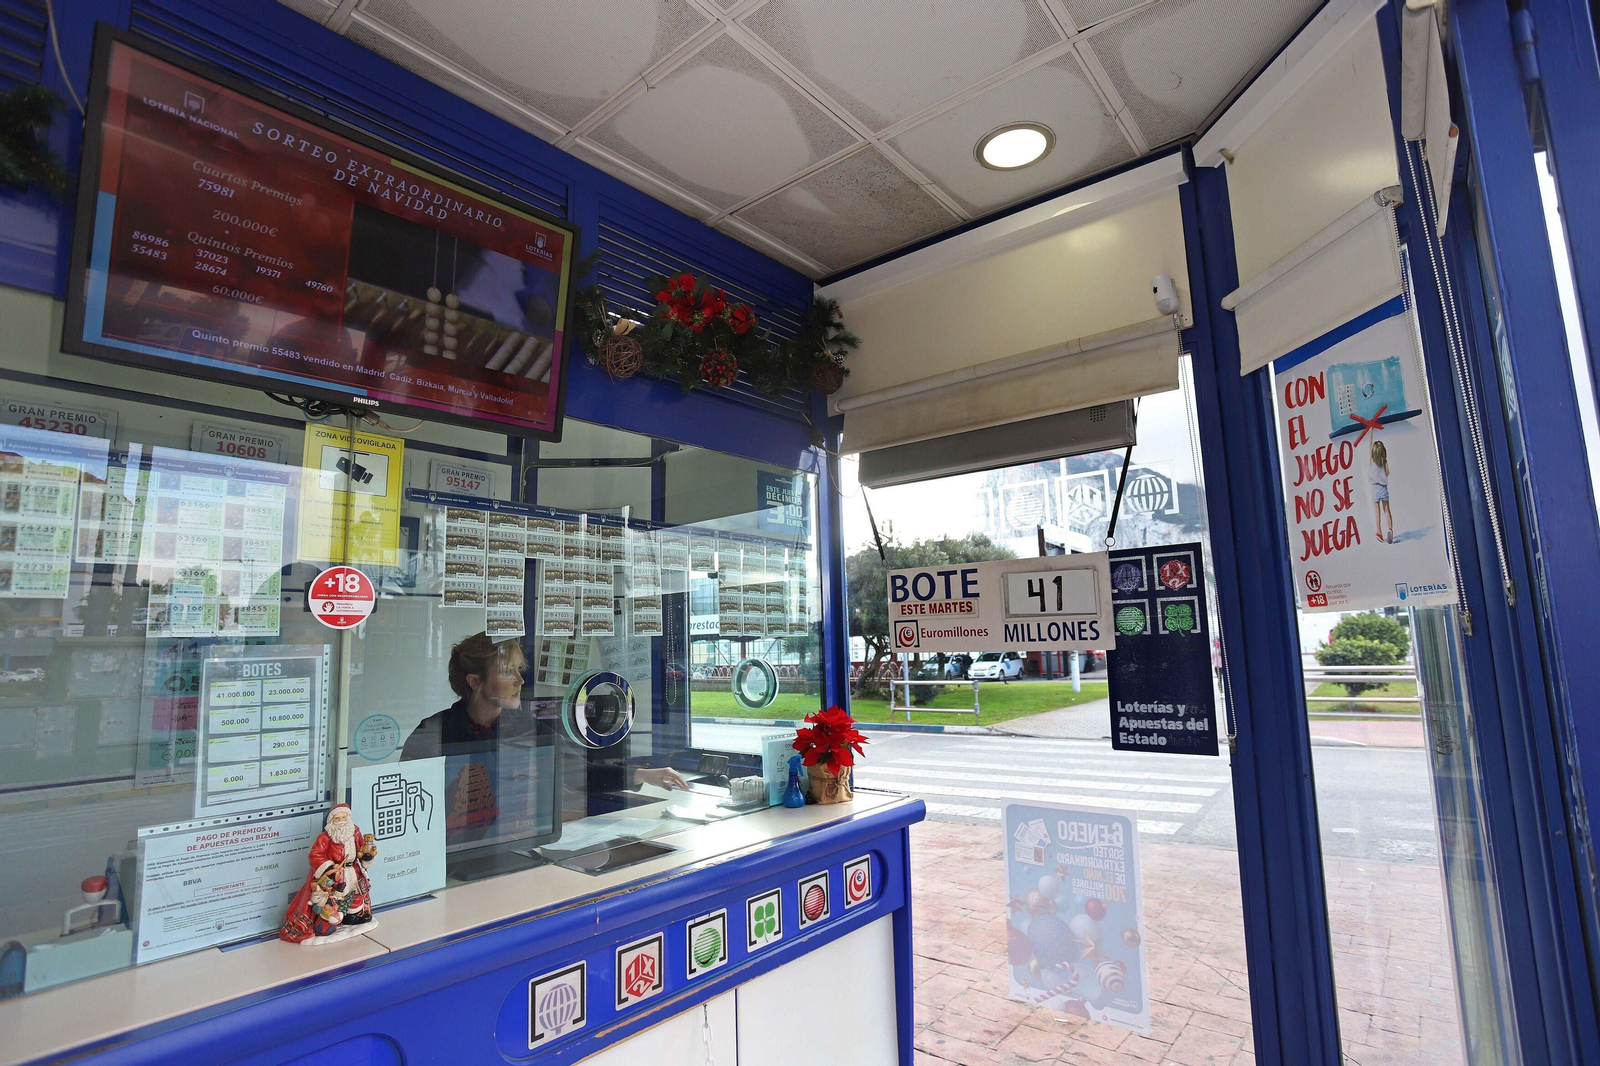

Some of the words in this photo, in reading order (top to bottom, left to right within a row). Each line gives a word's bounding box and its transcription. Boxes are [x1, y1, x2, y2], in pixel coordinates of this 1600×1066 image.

[142, 96, 186, 118] LOTERÍA
[189, 114, 239, 139] NACIONAL
[193, 160, 248, 187] Cuartos
[251, 181, 303, 206] Premios
[252, 121, 337, 163] SORTEO
[346, 159, 504, 229] EXTRAORDINARIO
[197, 178, 235, 199] 75981
[333, 168, 359, 188] DE
[366, 181, 448, 221] NAVIDAD
[212, 209, 279, 237] 200.000€
[131, 230, 169, 248] 86986
[131, 244, 167, 260] 55483
[187, 231, 241, 254] Quintos
[244, 247, 294, 270] Premios
[195, 248, 229, 264] 37023
[525, 244, 553, 259] LOTERÍAS
[194, 261, 228, 276] 28674
[256, 265, 281, 279] 19371
[211, 284, 264, 304] 60.000€
[304, 280, 334, 293] 49760
[192, 329, 230, 345] Quinto
[232, 339, 269, 355] premio
[272, 347, 301, 361] 55483
[303, 354, 340, 370] vendido
[342, 364, 354, 372] en
[447, 385, 472, 397] Murcia
[473, 391, 479, 400] y
[480, 391, 514, 406] Valladolid
[1284, 371, 1326, 410] CON
[353, 396, 380, 407] PHILIPS
[8, 404, 45, 416] GRAN
[50, 410, 97, 423] PREMIO
[18, 417, 87, 436] 45230
[1288, 415, 1310, 450] EL
[208, 430, 236, 441] GRAN
[239, 435, 274, 448] PREMIO
[315, 431, 337, 441] ZONA
[216, 441, 267, 459] 10608
[1293, 440, 1354, 487] JUEGO
[441, 467, 459, 477] GRAN
[462, 472, 486, 482] PREMIO
[446, 476, 481, 491] 95147
[766, 485, 780, 494] ESTE
[1295, 489, 1325, 524] NO
[1333, 476, 1355, 512] SE
[786, 518, 803, 527] EUROS
[1300, 515, 1361, 562] JUEGA
[323, 573, 360, 593] +18
[891, 568, 980, 602] BOTE
[1409, 583, 1448, 593] LOTERÍAS
[1027, 576, 1064, 613] 41
[1310, 594, 1325, 605] +18
[900, 602, 926, 616] ESTE
[928, 600, 973, 614] MARTES
[920, 626, 989, 639] Euromillones
[1004, 620, 1101, 643] MILLONES
[243, 662, 282, 677] BOTES
[216, 690, 256, 699] 41.000.000
[268, 687, 305, 696] 23.000.000
[1117, 700, 1174, 714] Loterías
[1176, 703, 1186, 717] y
[221, 717, 250, 726] 500.000
[268, 713, 304, 722] 10.800.000
[1118, 716, 1184, 735] Apuestas
[1186, 717, 1209, 732] del
[272, 740, 299, 749] 290.000
[1119, 731, 1167, 747] Estado
[223, 775, 244, 784] 6.000
[269, 767, 302, 777] 1.830.000
[186, 844, 198, 852] DE
[199, 838, 239, 850] APUESTAS
[240, 835, 254, 843] con
[255, 831, 280, 841] BIZUM
[196, 833, 218, 843] PAGO
[220, 832, 230, 840] DE
[232, 825, 267, 837] PREMIOS
[255, 862, 280, 873] BANKIA
[387, 872, 397, 880] Pay
[397, 869, 406, 877] with
[407, 866, 418, 874] Card
[183, 877, 202, 887] BBVA
[211, 881, 245, 893] IMPORTANTE
